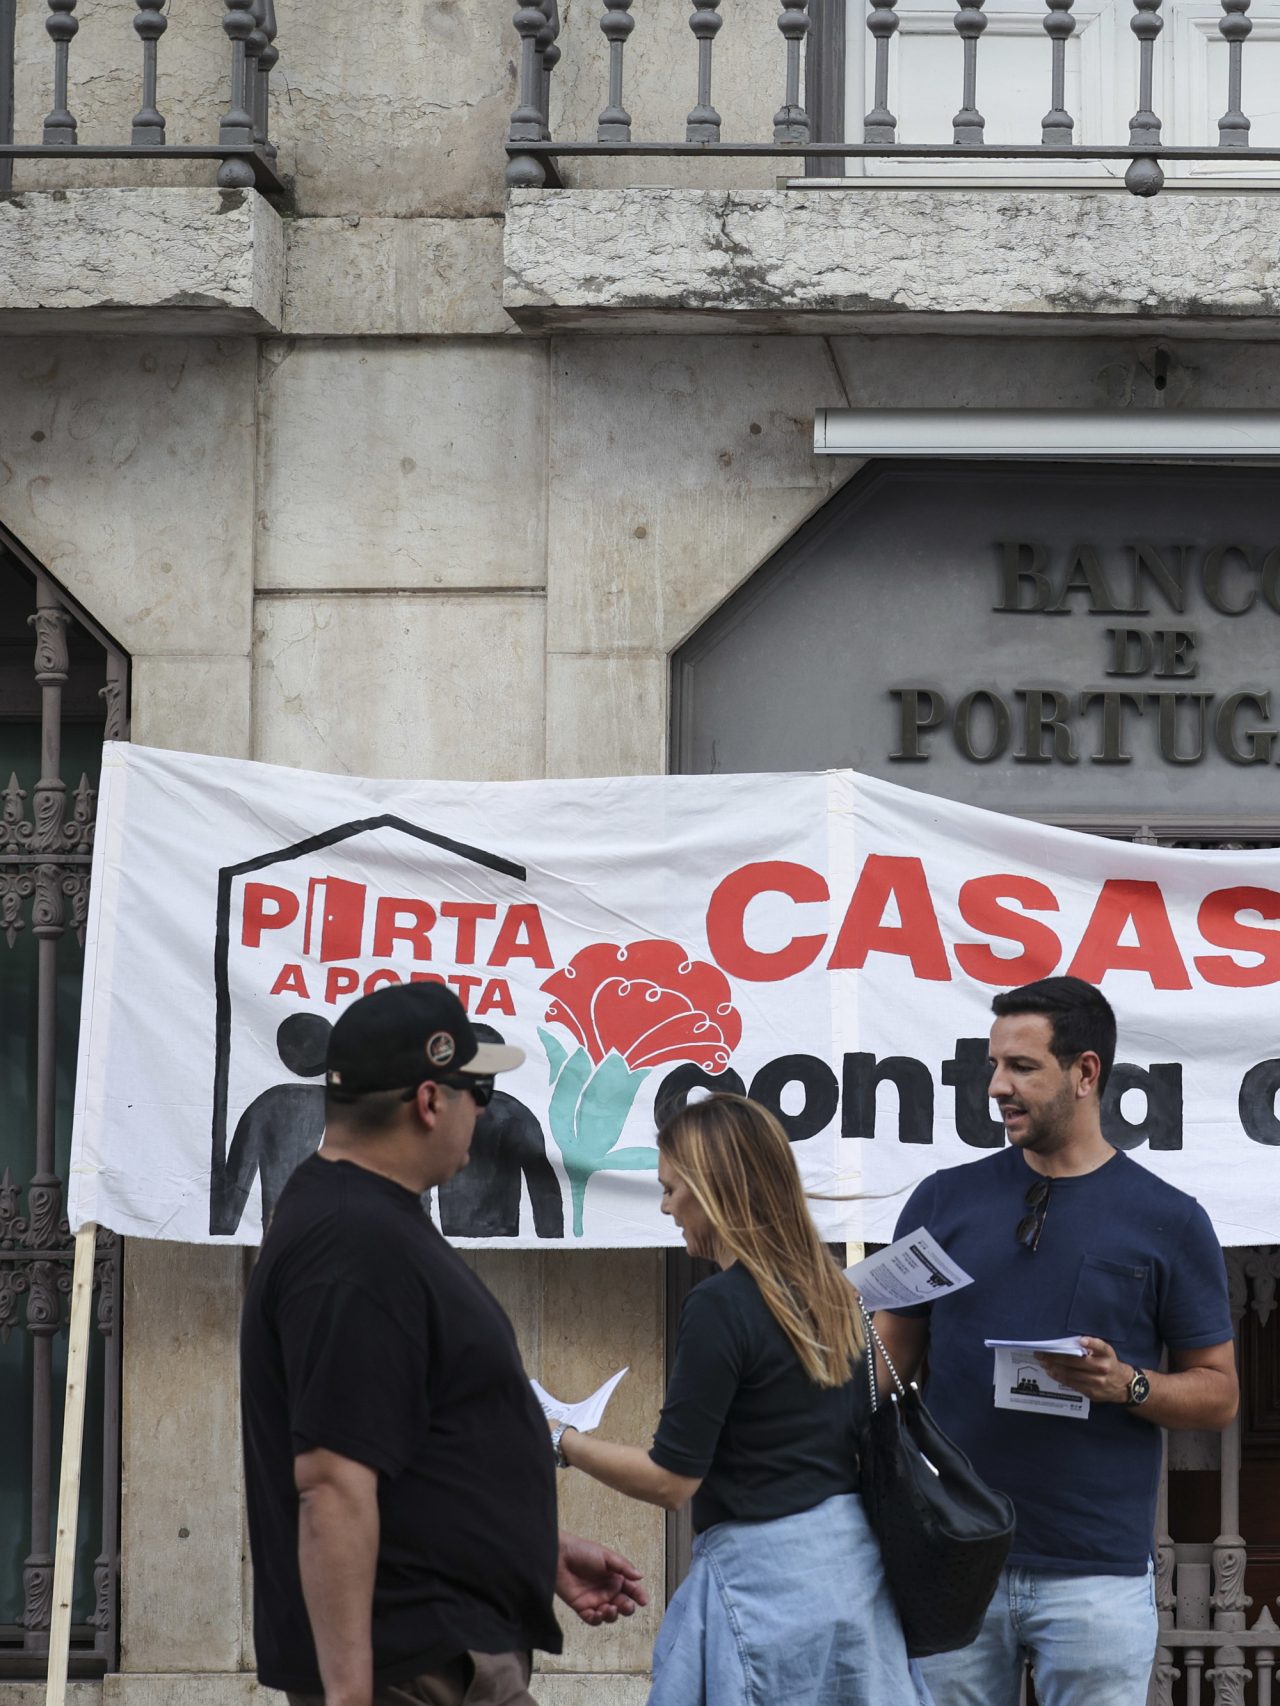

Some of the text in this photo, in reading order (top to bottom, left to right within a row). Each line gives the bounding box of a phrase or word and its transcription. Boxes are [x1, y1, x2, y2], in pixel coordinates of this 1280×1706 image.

[1105, 627, 1199, 678] DE
[270, 963, 517, 1017] A POTA
[653, 1036, 1184, 1151] conta
